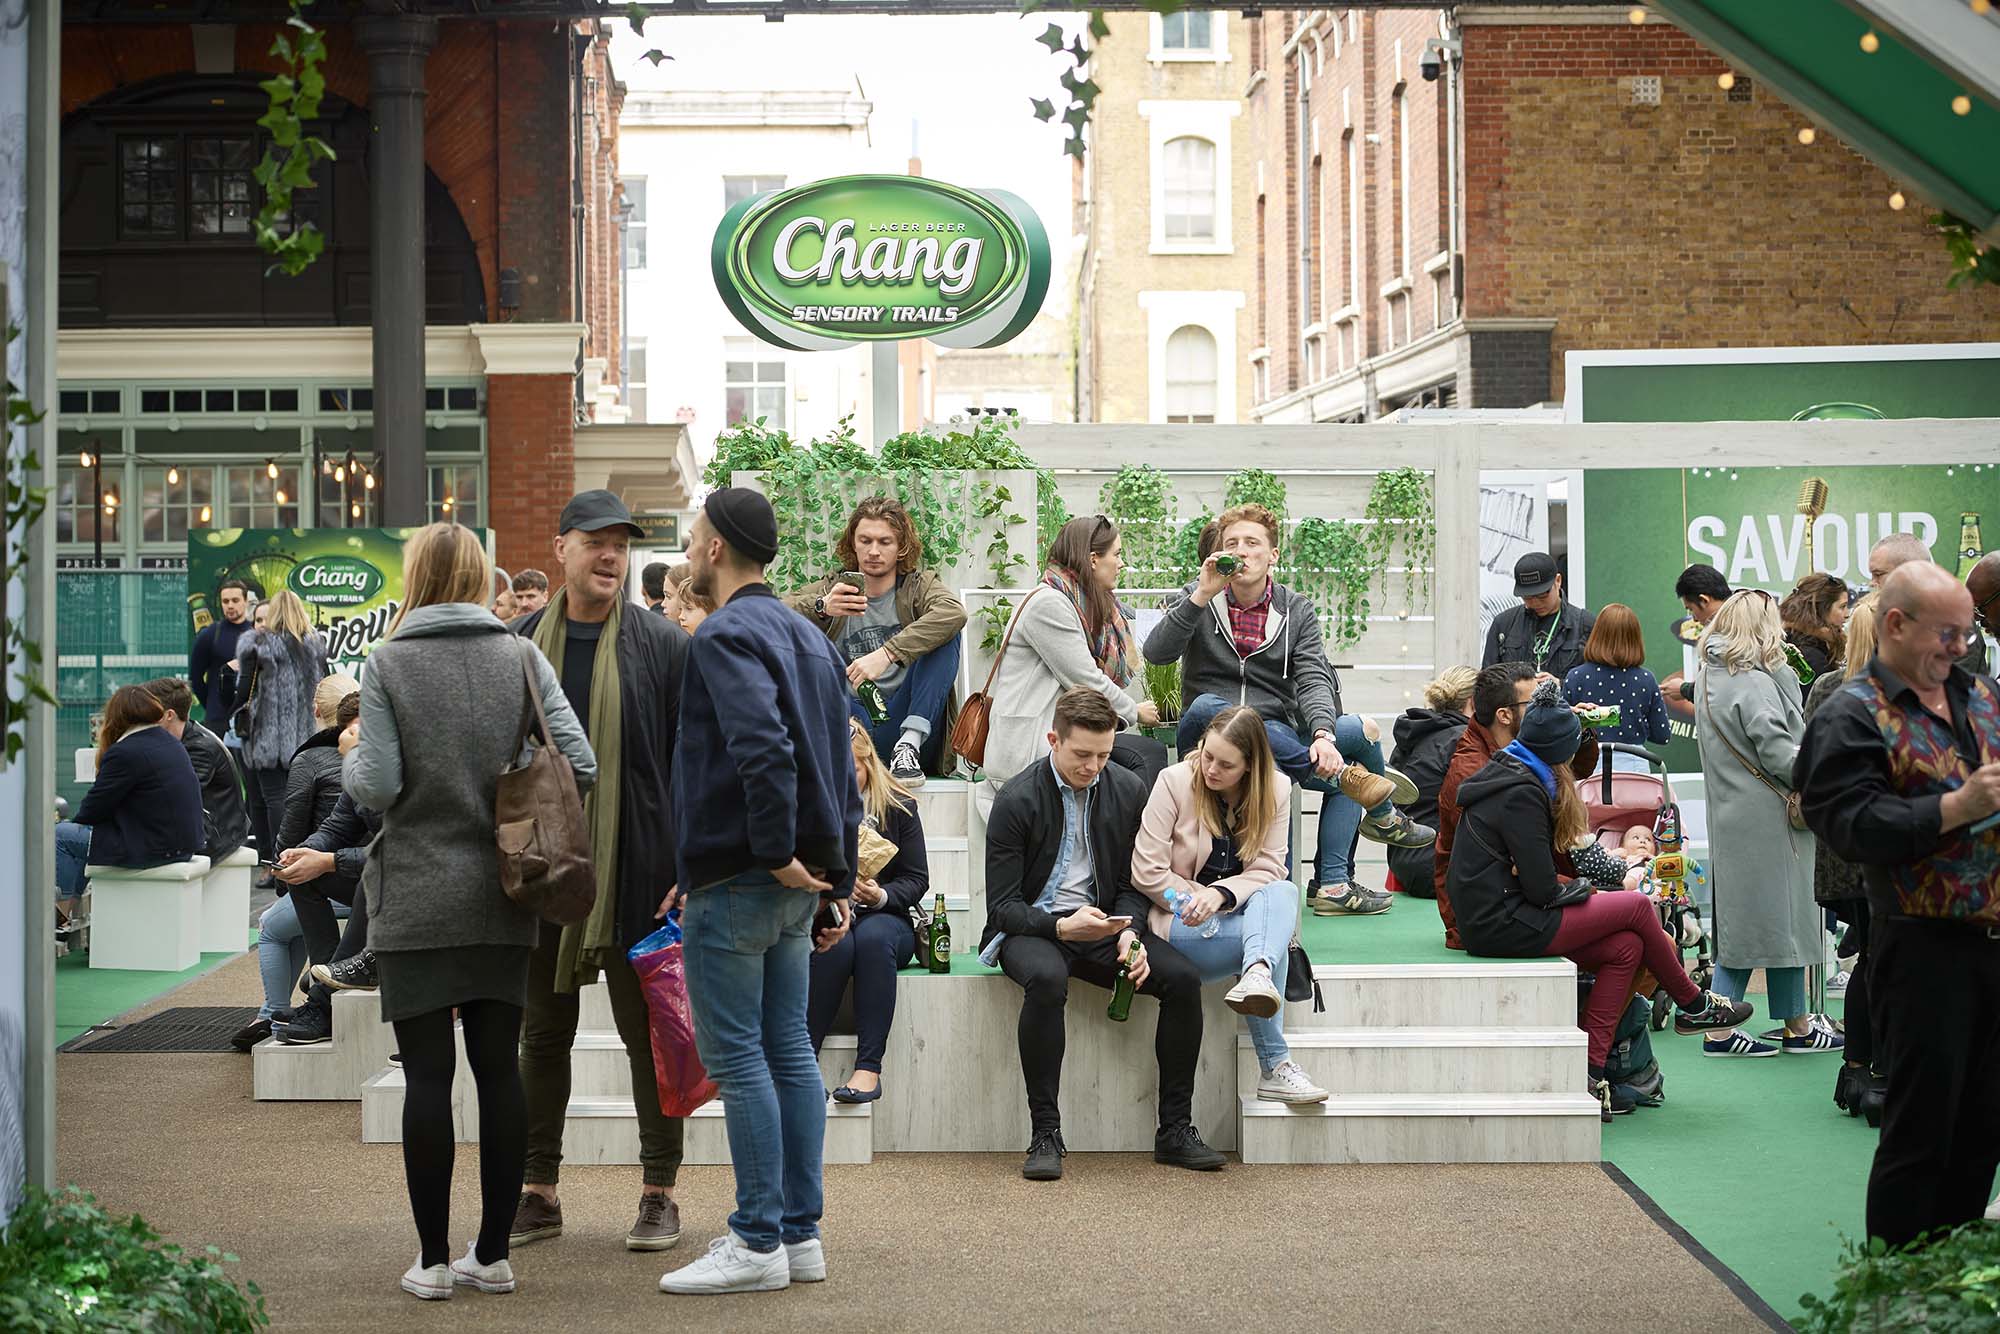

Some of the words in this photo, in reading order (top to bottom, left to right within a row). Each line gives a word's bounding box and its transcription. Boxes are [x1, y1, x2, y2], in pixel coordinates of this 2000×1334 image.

[869, 223, 920, 232] LAGER
[926, 223, 966, 232] BEER
[772, 216, 985, 298] Chang
[791, 305, 885, 322] SENSORY
[891, 306, 960, 322] TRAILS
[300, 565, 368, 591] Chang
